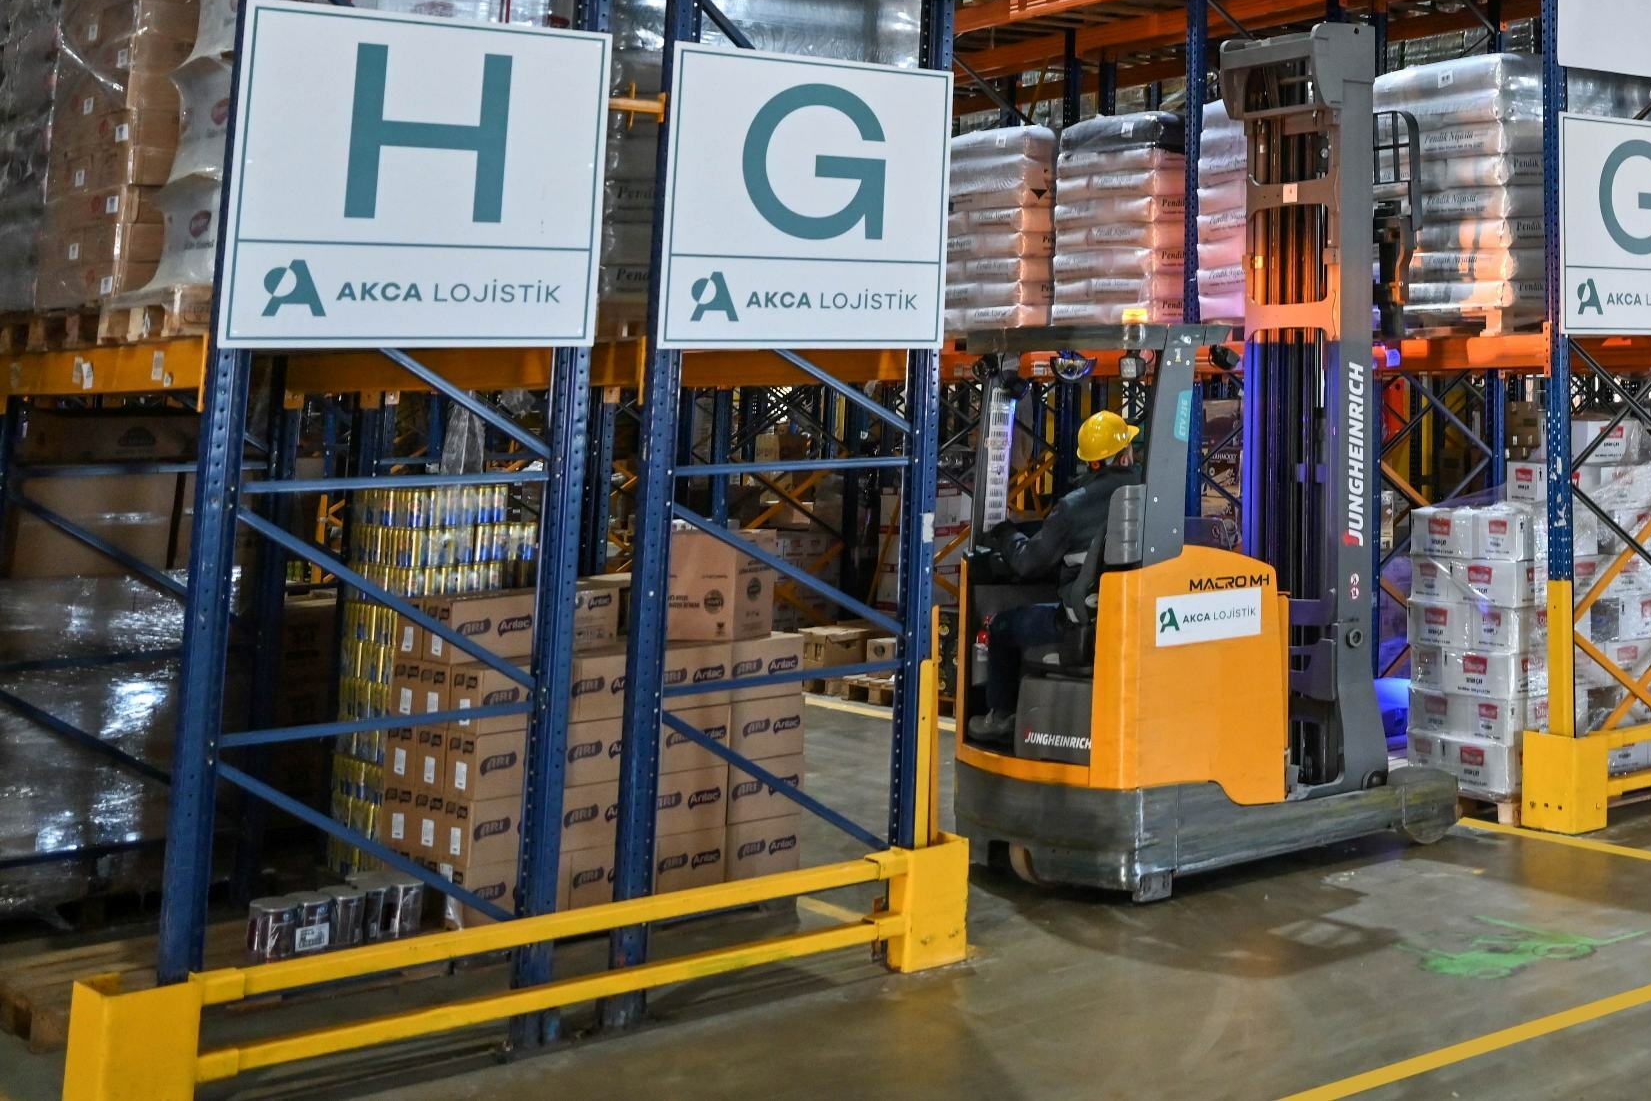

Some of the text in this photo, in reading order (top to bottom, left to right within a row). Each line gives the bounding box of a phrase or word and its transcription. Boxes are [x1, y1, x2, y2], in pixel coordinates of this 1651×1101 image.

[343, 42, 513, 224] H
[741, 82, 887, 241] G
[617, 186, 654, 199] Pend
[336, 278, 562, 305] AKCA LOJİSTİK
[745, 287, 919, 312] AKCA LOJİSTİK
[1606, 292, 1642, 306] AKCA
[1162, 301, 1184, 310] Pendi
[1347, 361, 1364, 547] JUNGHEINRICH
[1189, 575, 1247, 591] MACRO
[1182, 606, 1256, 623] AKCA LOJİSTİK
[1024, 730, 1092, 750] JUNGHEINRICH
